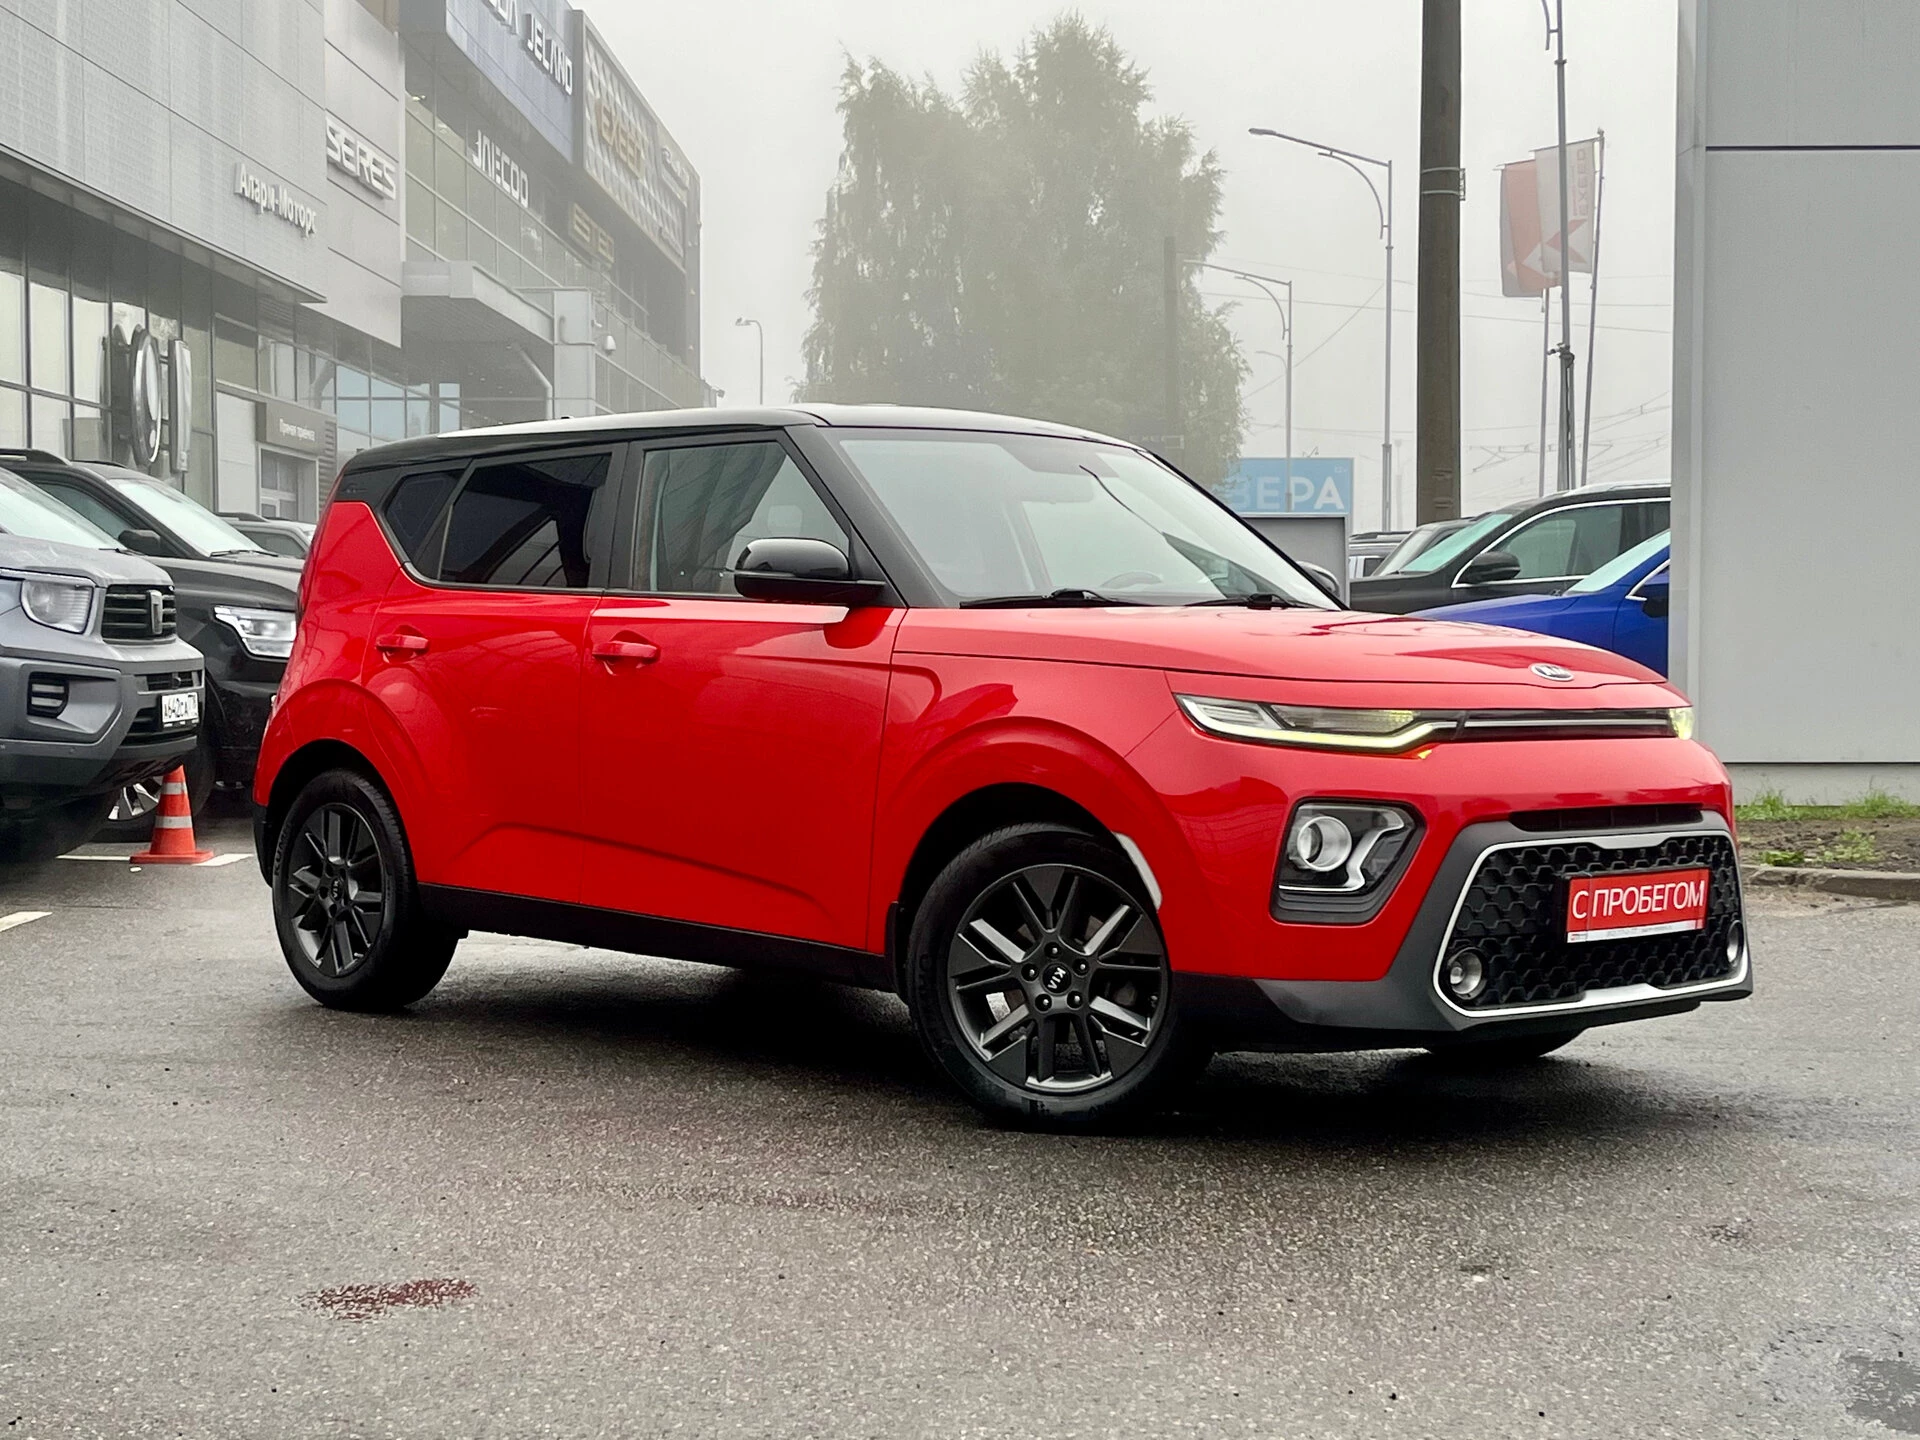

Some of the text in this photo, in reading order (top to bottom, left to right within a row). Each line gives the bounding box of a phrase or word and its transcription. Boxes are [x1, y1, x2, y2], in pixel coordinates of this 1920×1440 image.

[526, 14, 573, 95] JELAND
[326, 116, 396, 200] SERES
[472, 129, 529, 208] JAECOO
[1572, 880, 1705, 919] С ПРОБЕГОМ
[1047, 967, 1066, 989] KIA
